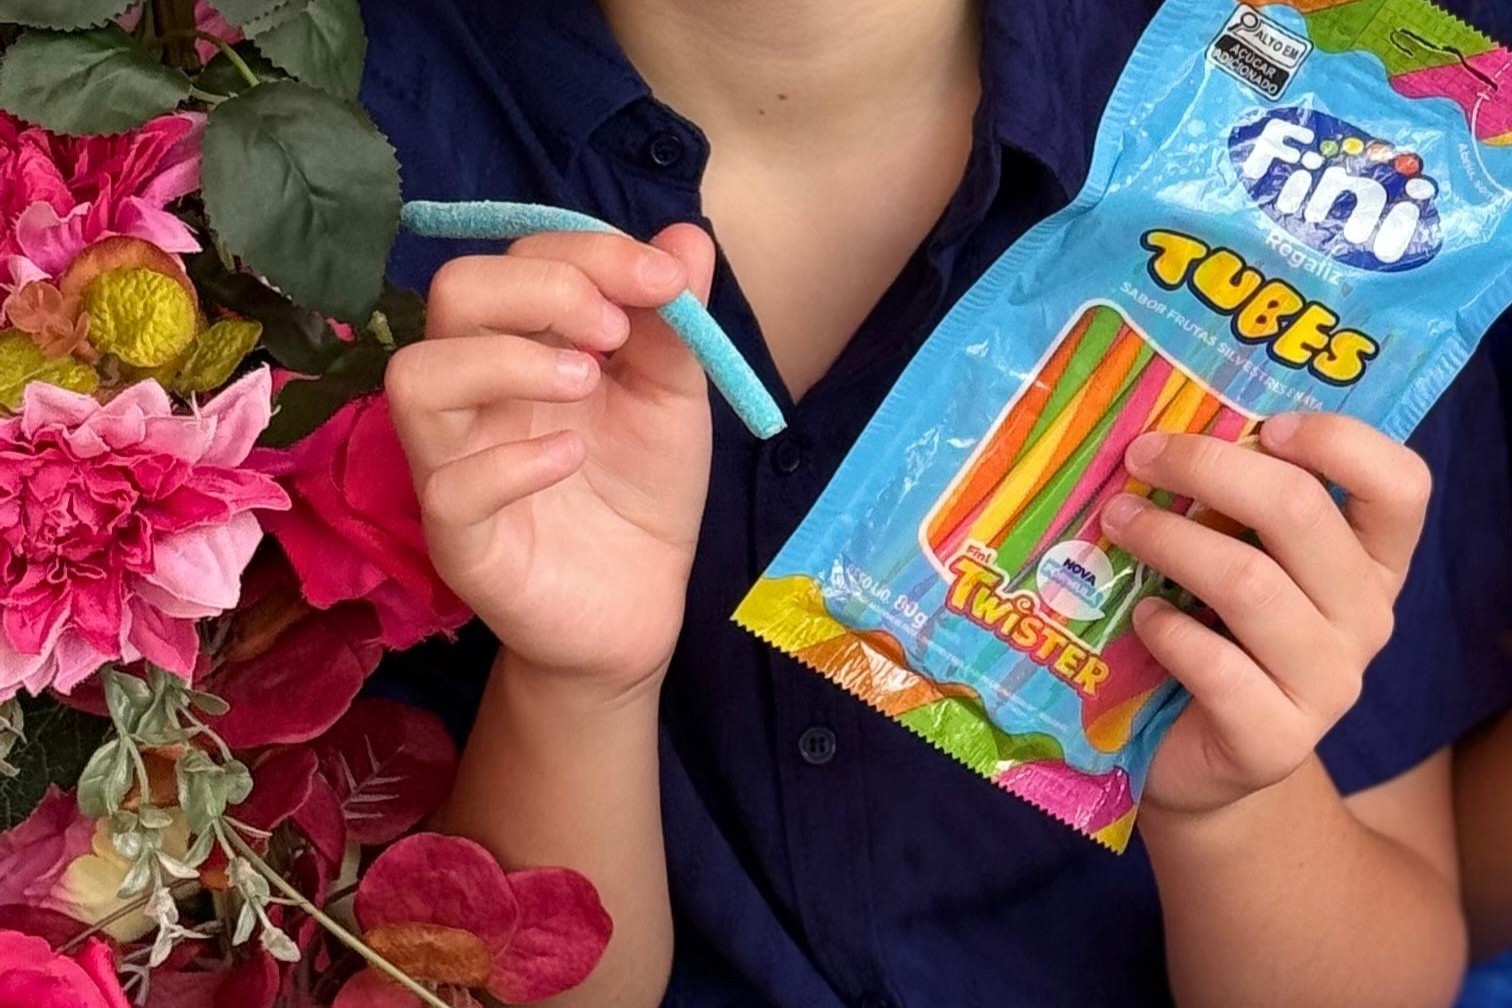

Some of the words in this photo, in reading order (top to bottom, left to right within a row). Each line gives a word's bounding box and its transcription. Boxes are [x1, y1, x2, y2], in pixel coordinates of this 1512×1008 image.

[1254, 30, 1283, 52] ALTO
[1282, 45, 1300, 61] EM
[1212, 49, 1278, 95] ADICIONADO
[1265, 230, 1345, 287] Regaliz
[1141, 229, 1380, 385] TUBES
[1119, 281, 1165, 315] SABOR
[1166, 308, 1218, 347] FRUTAS
[1217, 342, 1287, 395] SILVESTRES
[1063, 557, 1096, 587] NOVA
[893, 594, 929, 630] 80g
